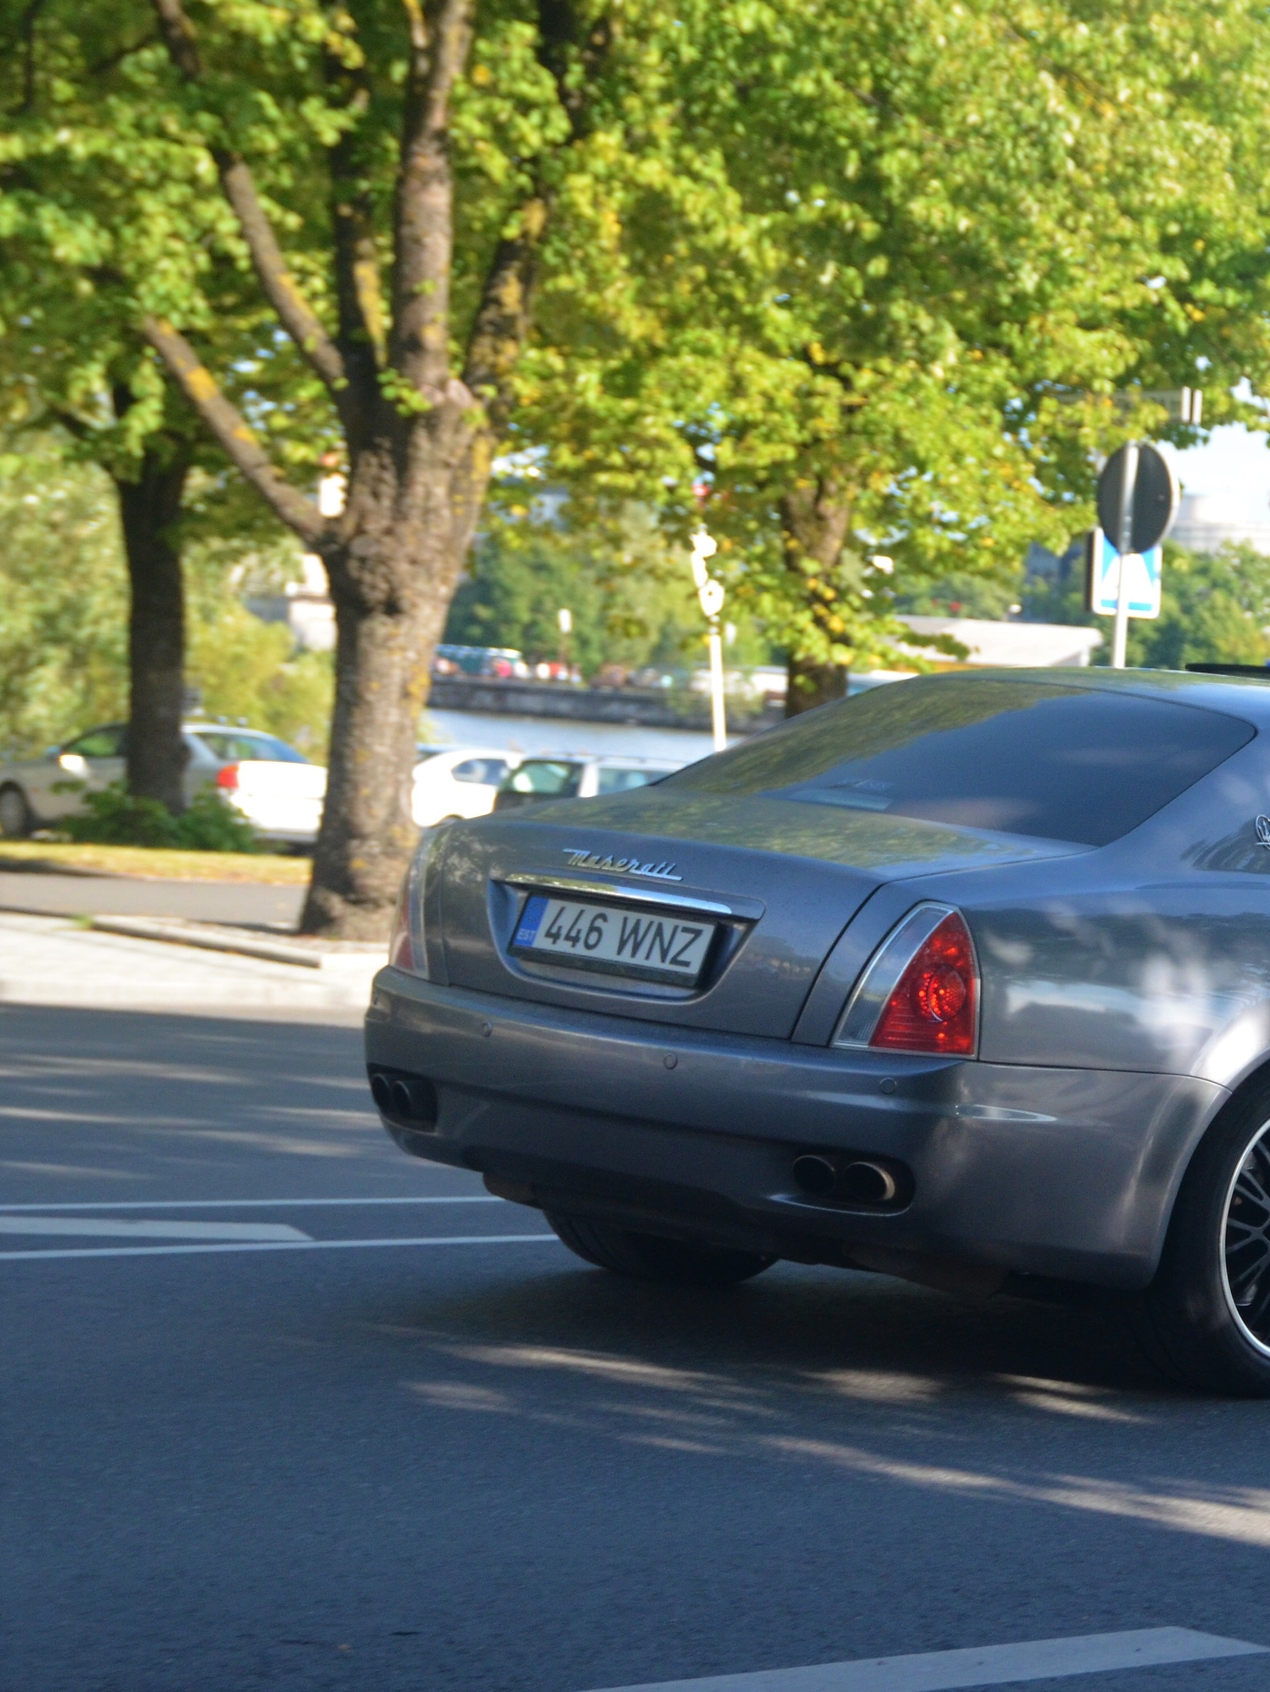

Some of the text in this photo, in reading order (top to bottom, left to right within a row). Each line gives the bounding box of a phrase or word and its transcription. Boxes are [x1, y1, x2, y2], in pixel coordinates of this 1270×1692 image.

[562, 847, 683, 882] Maserati
[516, 928, 537, 943] EST
[543, 905, 703, 967] 446 WNZ
